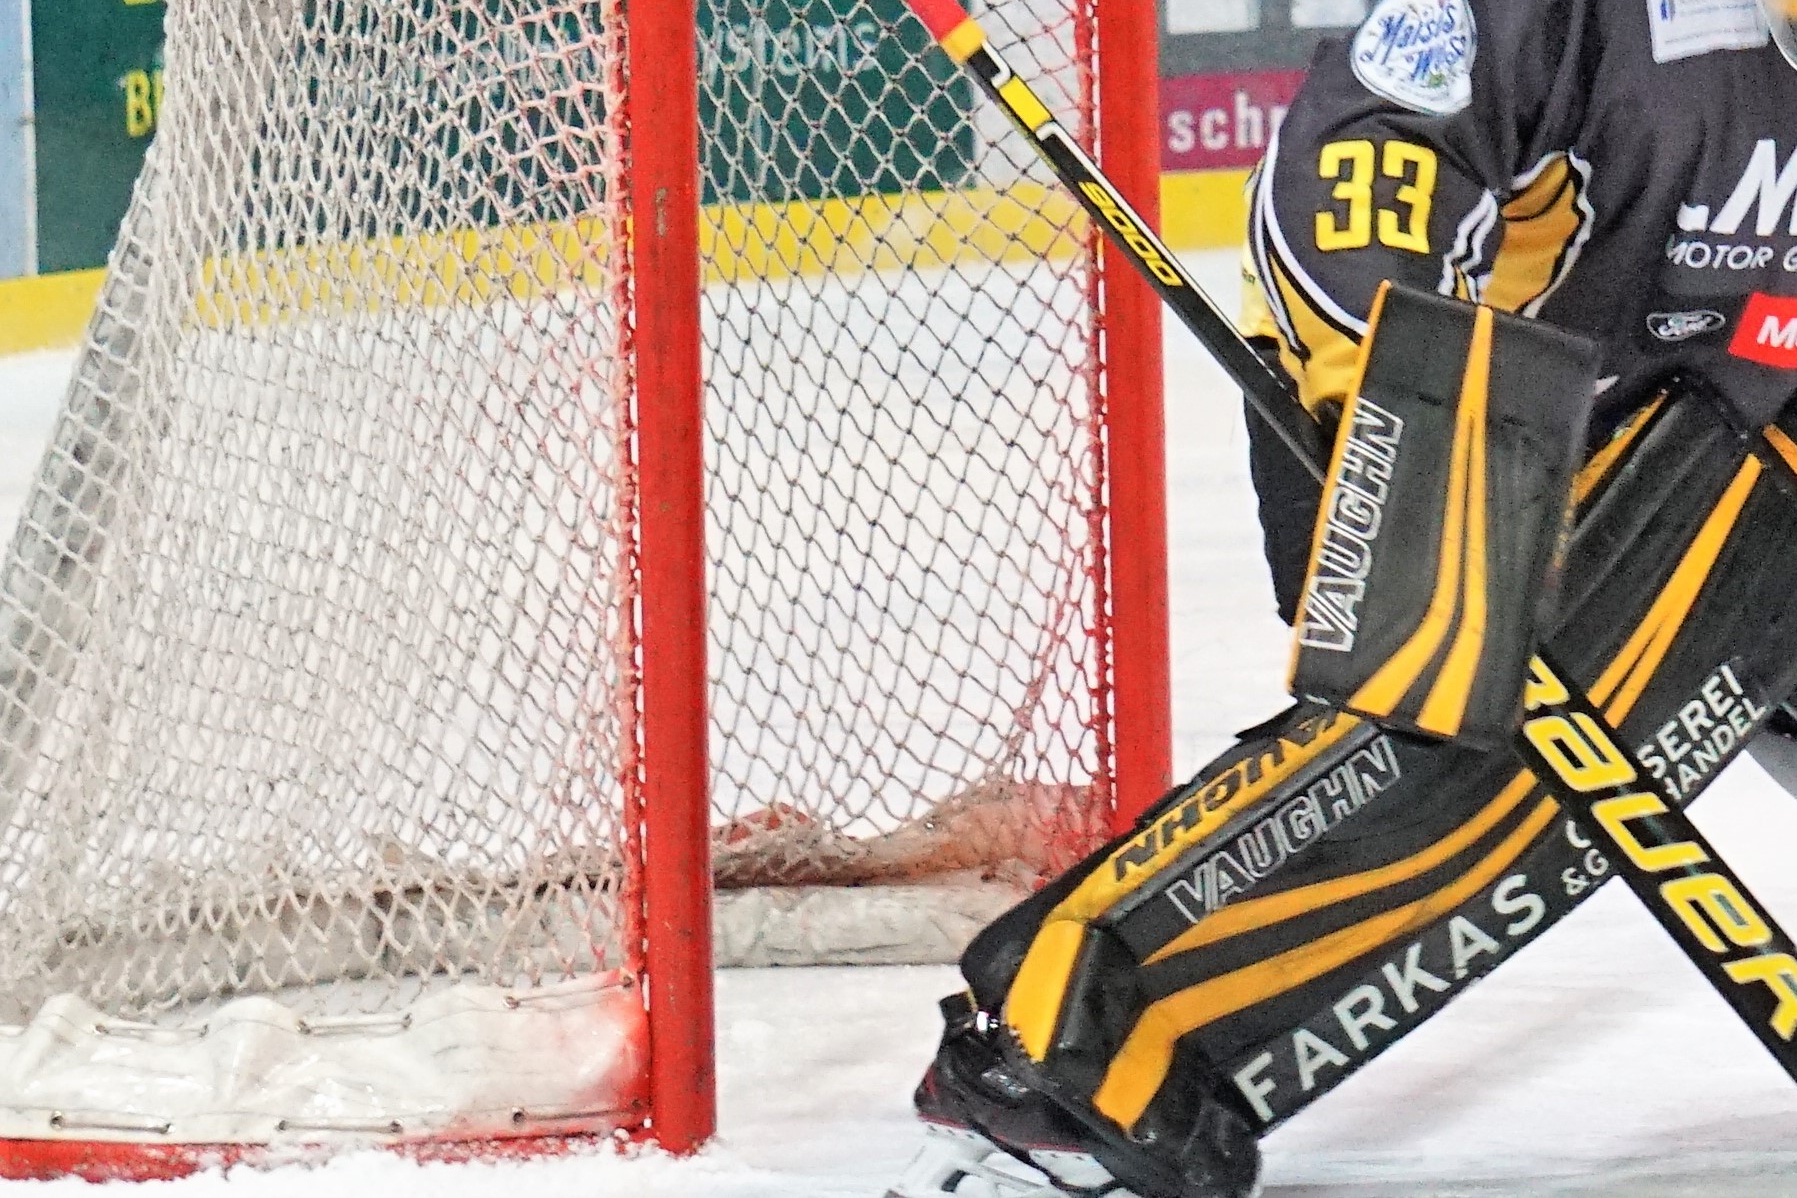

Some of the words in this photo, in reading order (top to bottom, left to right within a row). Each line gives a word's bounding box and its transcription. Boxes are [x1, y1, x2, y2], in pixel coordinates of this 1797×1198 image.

[1314, 139, 1440, 253] 33
[1668, 236, 1774, 270] MOTOR
[1298, 396, 1404, 653] VAUGHN
[1164, 734, 1401, 924] VAUGHN
[1232, 871, 1548, 1124] FARKAS
